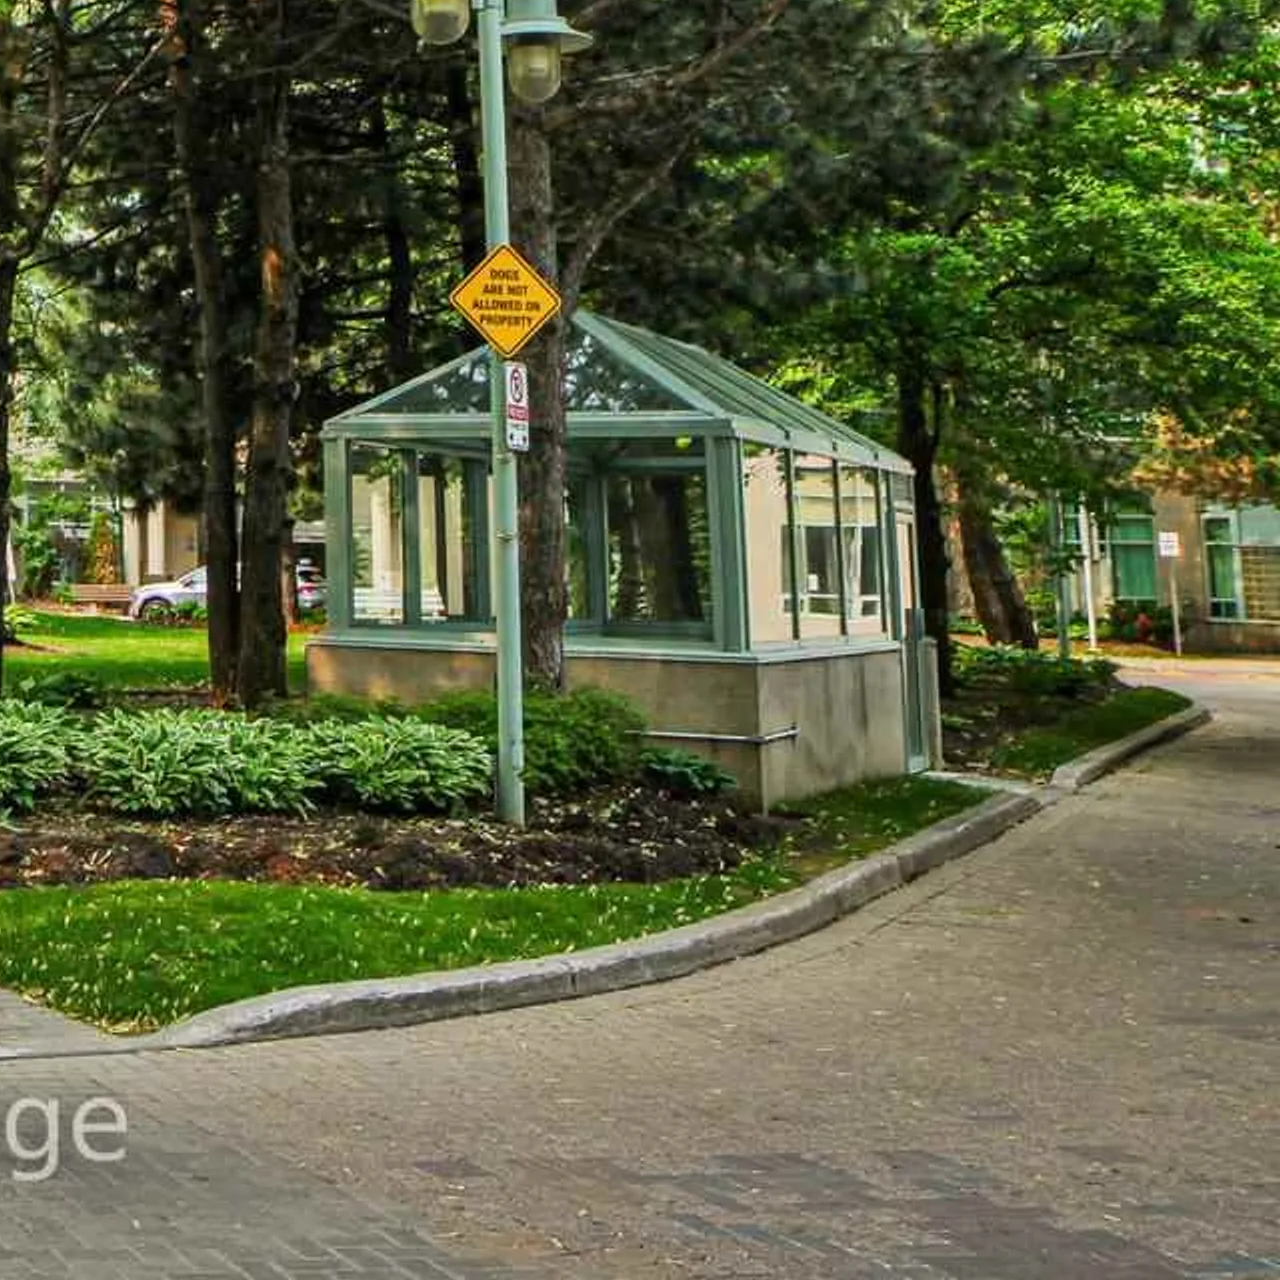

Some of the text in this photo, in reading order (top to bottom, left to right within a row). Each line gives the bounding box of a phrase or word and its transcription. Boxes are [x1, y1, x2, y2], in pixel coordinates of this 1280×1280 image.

[490, 270, 519, 281] DOGS
[483, 283, 528, 297] ARE NOT
[472, 299, 540, 312] ALLOWED ON
[480, 314, 532, 329] PROPERTY
